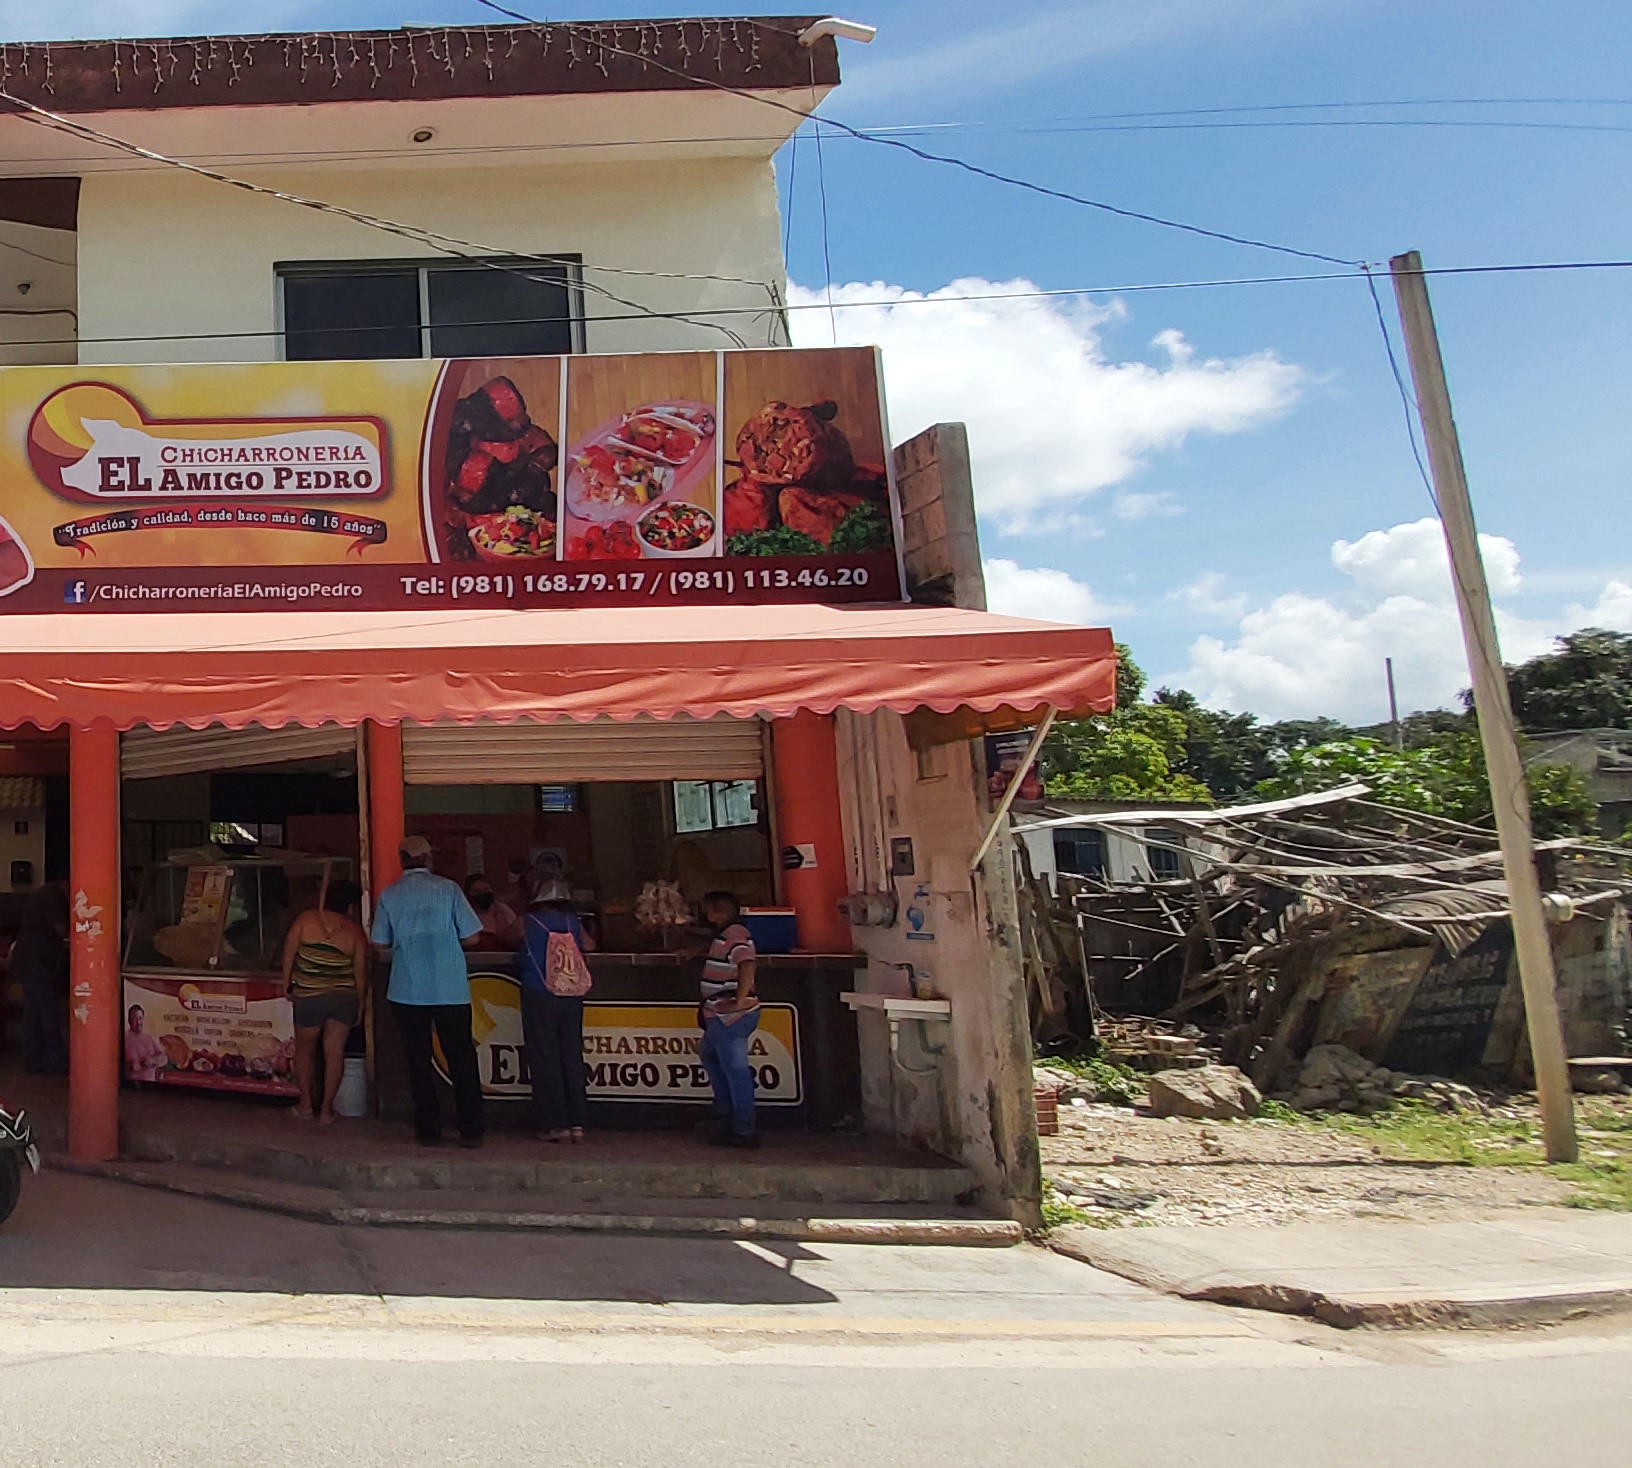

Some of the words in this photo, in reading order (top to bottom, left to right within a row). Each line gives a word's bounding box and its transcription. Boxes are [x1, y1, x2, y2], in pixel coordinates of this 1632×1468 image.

[98, 456, 152, 492] EL
[158, 468, 264, 491] AMIGO
[273, 467, 372, 490] PEDRO
[131, 518, 139, 529] y
[197, 510, 233, 521] desde
[237, 510, 267, 521] hace
[271, 513, 296, 523] más
[301, 513, 317, 526] de
[323, 516, 339, 528] 15
[400, 576, 445, 595] Tel:
[451, 575, 514, 598] (981)
[523, 573, 645, 593] 168.79.17
[670, 571, 734, 595] (981)
[744, 568, 868, 588] 113.46.20
